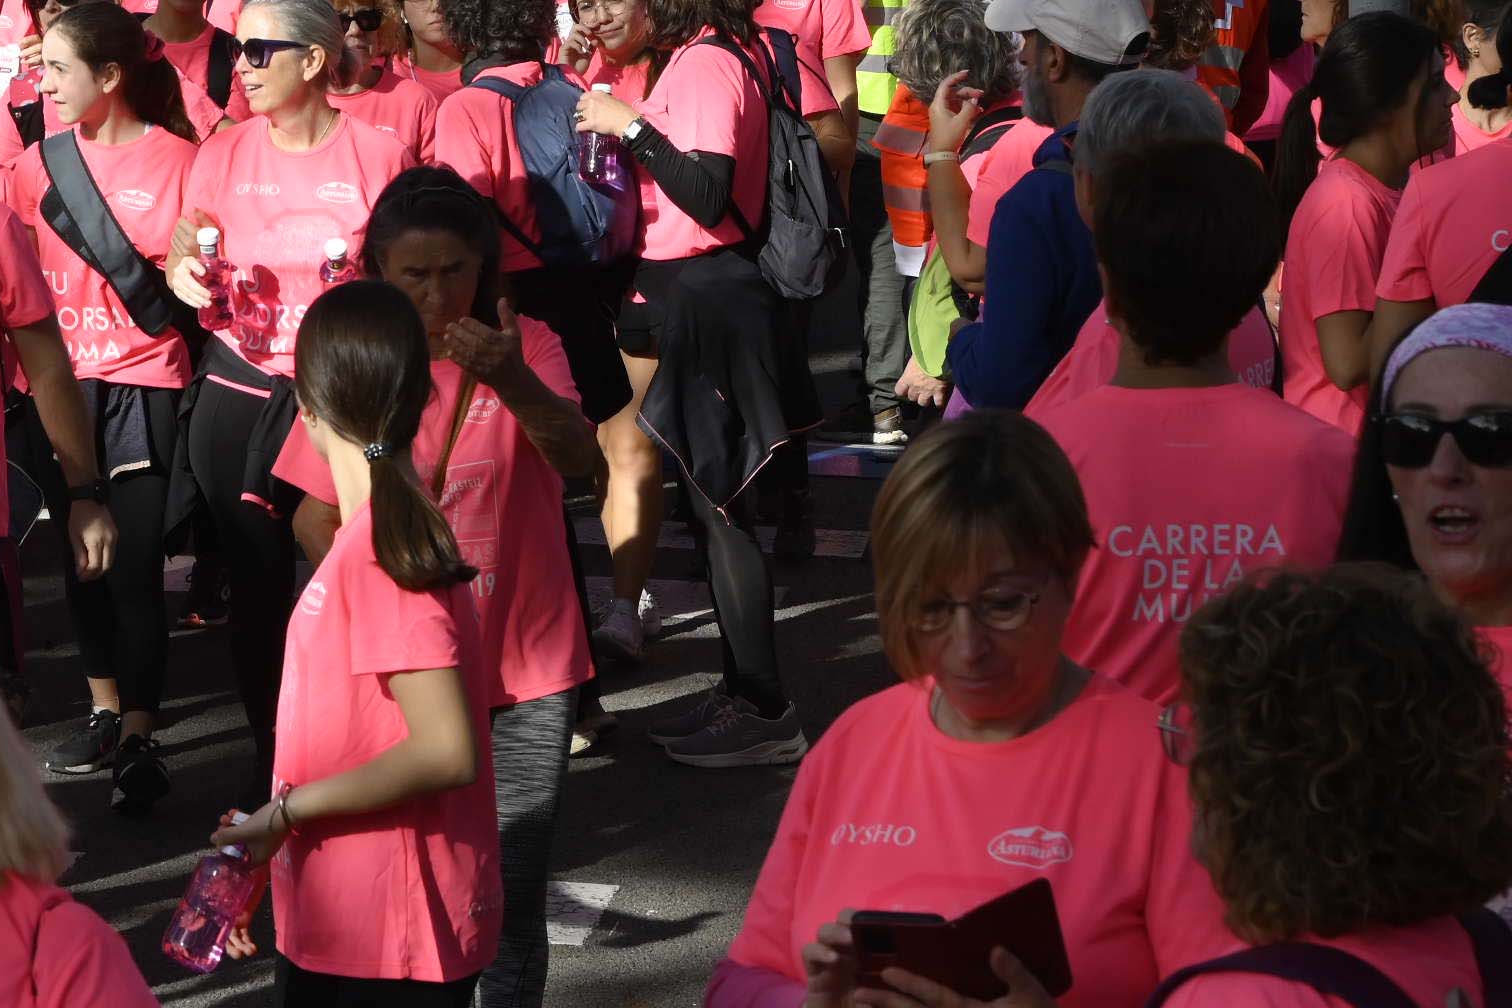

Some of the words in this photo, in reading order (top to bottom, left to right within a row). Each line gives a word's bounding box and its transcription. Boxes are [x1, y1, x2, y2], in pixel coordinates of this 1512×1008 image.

[1108, 523, 1287, 557] CARRERA
[1144, 559, 1189, 591] DE
[1204, 557, 1244, 590] LA
[831, 823, 918, 847] OYSHO
